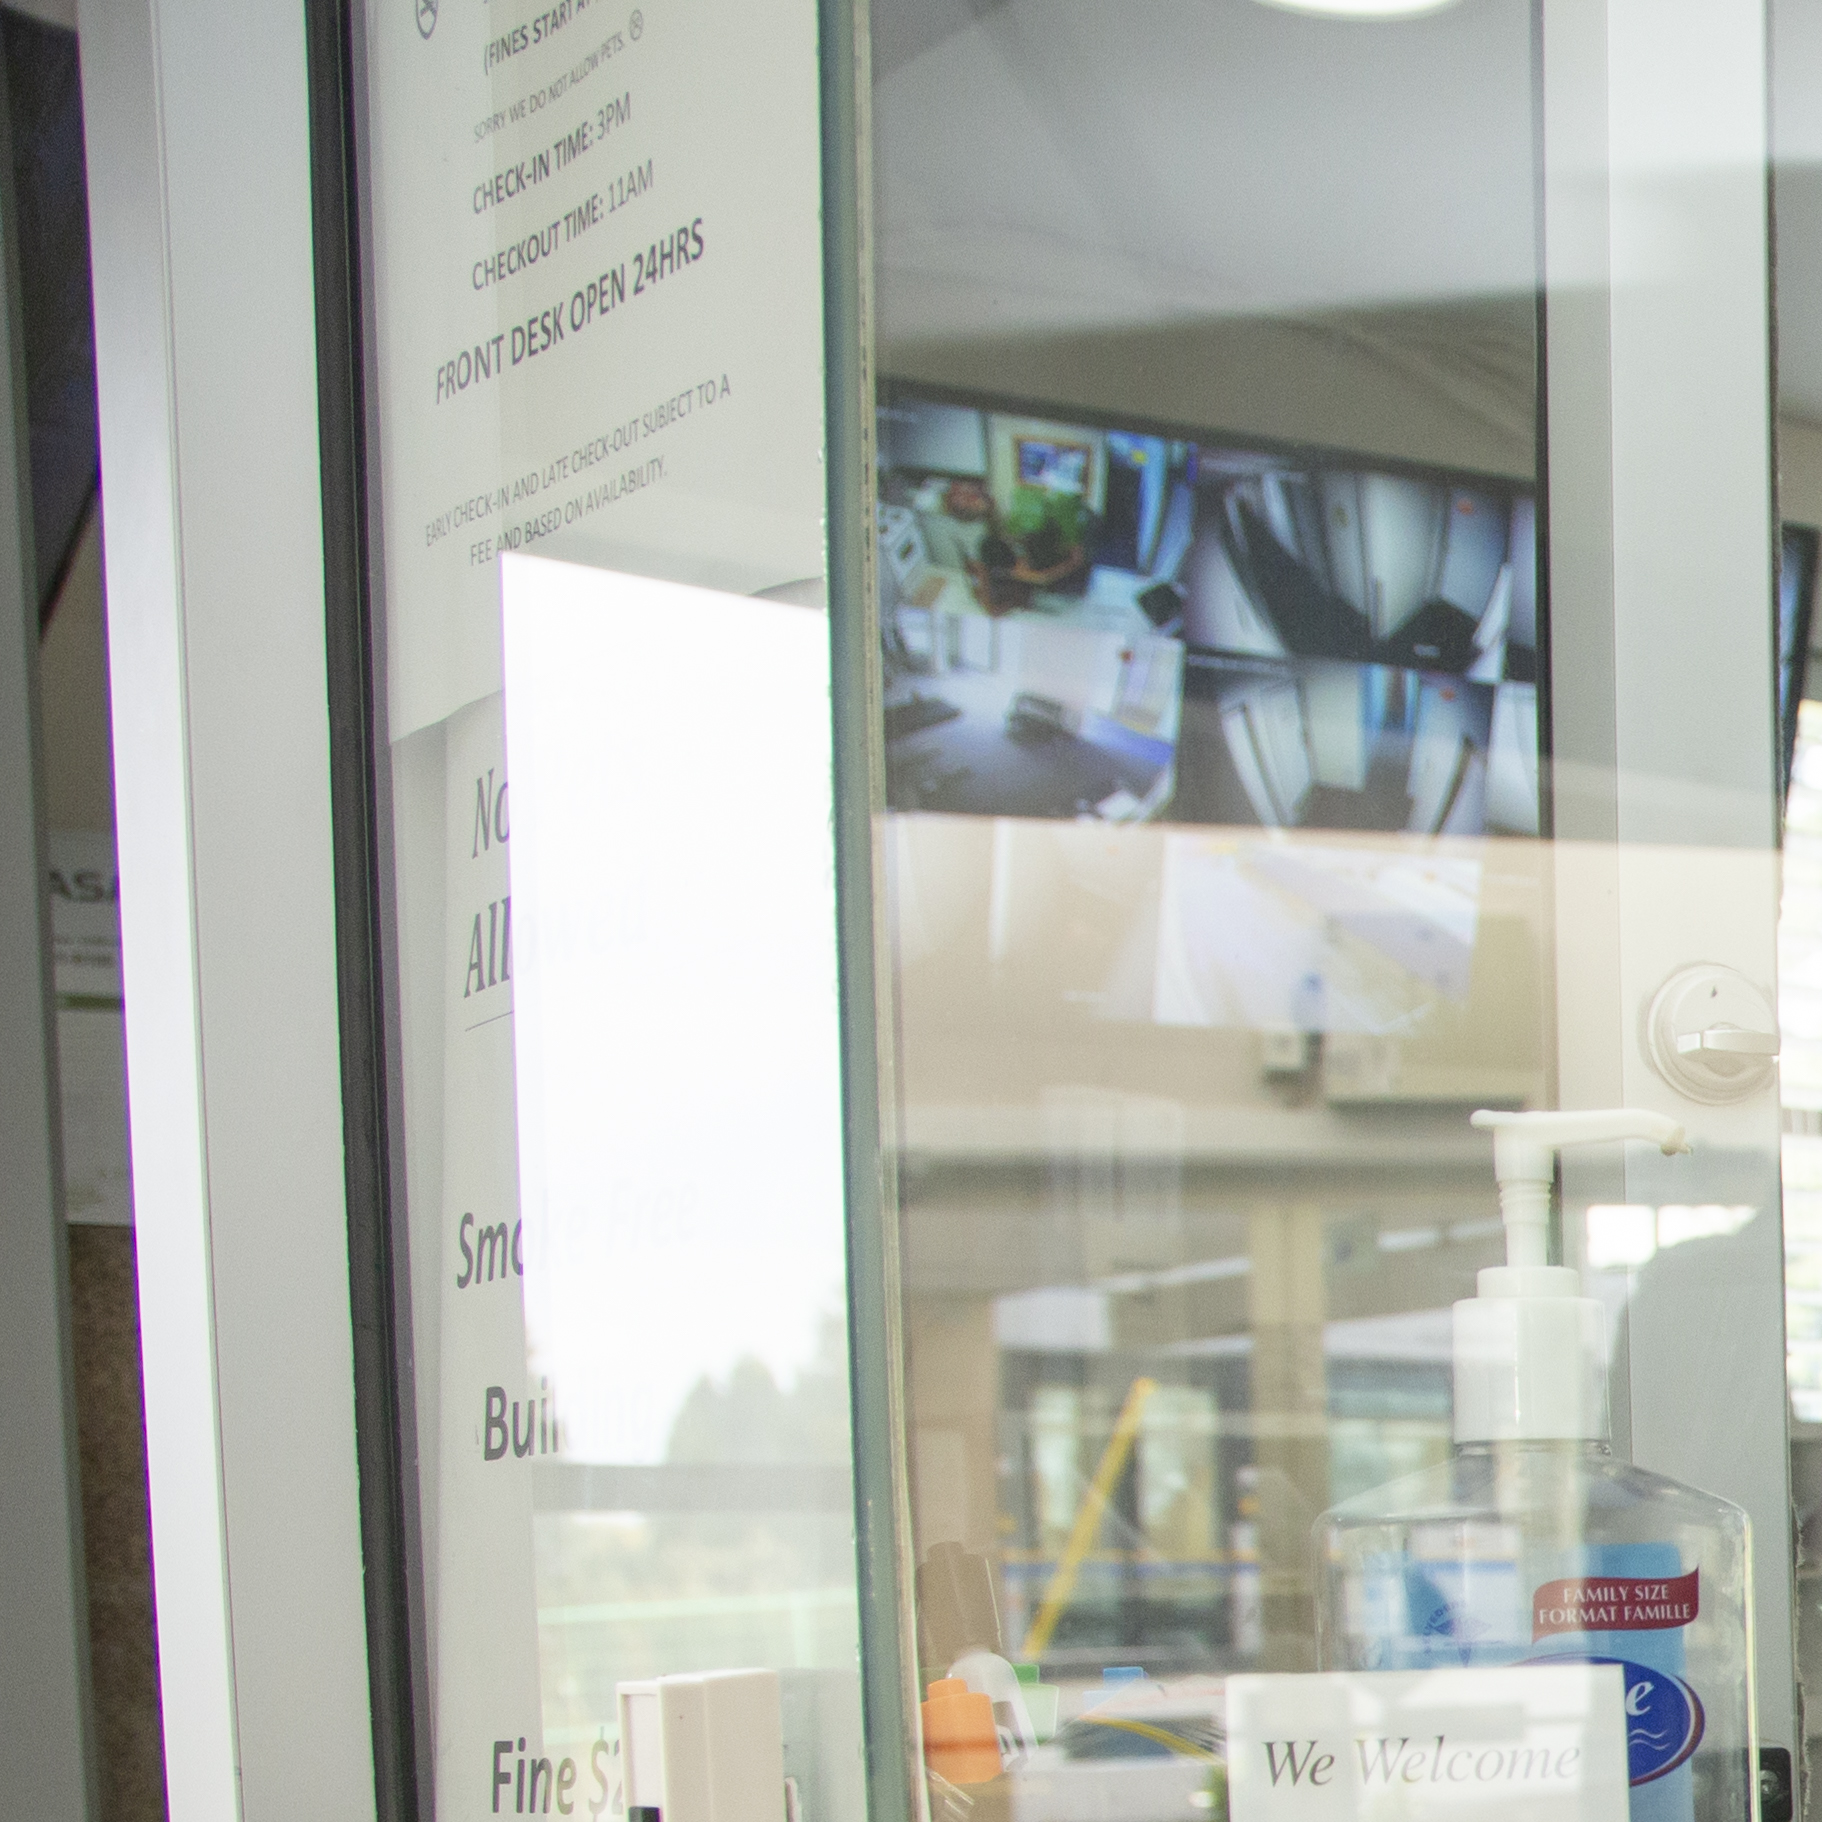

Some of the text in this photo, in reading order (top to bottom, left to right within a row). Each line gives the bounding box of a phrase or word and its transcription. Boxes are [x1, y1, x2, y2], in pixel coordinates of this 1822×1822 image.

[484, 25, 529, 76] (FINES
[533, 0, 573, 44] START
[474, 113, 506, 143] SORRY
[509, 99, 526, 123] WE
[529, 89, 547, 113] DO
[549, 74, 568, 104] NOT
[569, 53, 600, 86] ALLOW
[473, 91, 631, 215] CHECK-IN TIME: 3PM
[472, 158, 653, 291] CHECKOUT TIME: 11AM
[436, 217, 704, 405] FRONT DESK OPEN 24HRS
[425, 373, 731, 547] EARLY CHECK-IN AND LATE CHECK-OUT SUBJECT TO A
[470, 454, 668, 566] FEE AND BASED ON AVAILABILITY.
[1539, 1603, 1692, 1625] FORMAT FAMILLE
[1563, 1583, 1670, 1604] FAMILY SIZE
[491, 1736, 577, 1816] Fine
[1263, 1734, 1581, 1787] We Welcome
